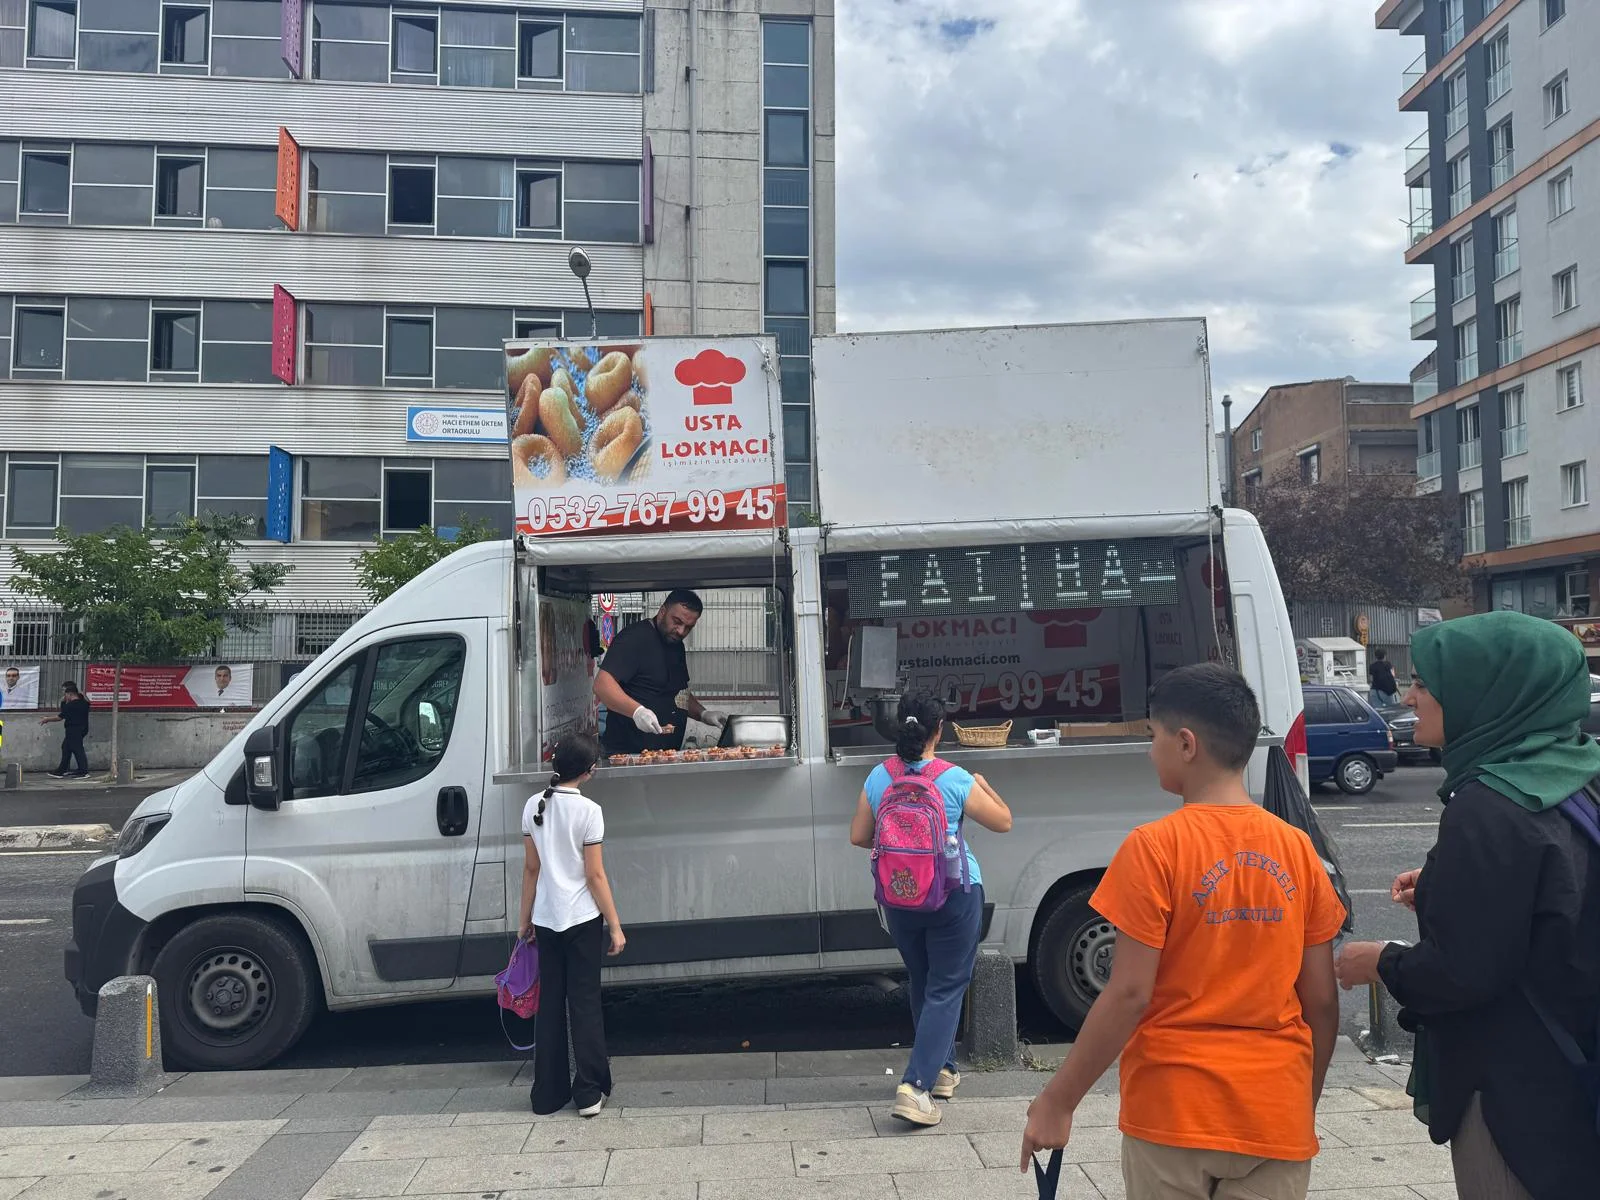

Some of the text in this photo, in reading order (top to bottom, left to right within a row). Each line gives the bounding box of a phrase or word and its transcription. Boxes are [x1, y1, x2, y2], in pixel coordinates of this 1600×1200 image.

[685, 414, 742, 432] USTA
[661, 439, 768, 459] LOKMACI
[527, 487, 774, 530] 0532 767 99 45
[897, 617, 1017, 639] LOKMACI
[999, 670, 1044, 711] 99
[1057, 668, 1102, 708] 45
[1234, 851, 1297, 901] VEYSEL
